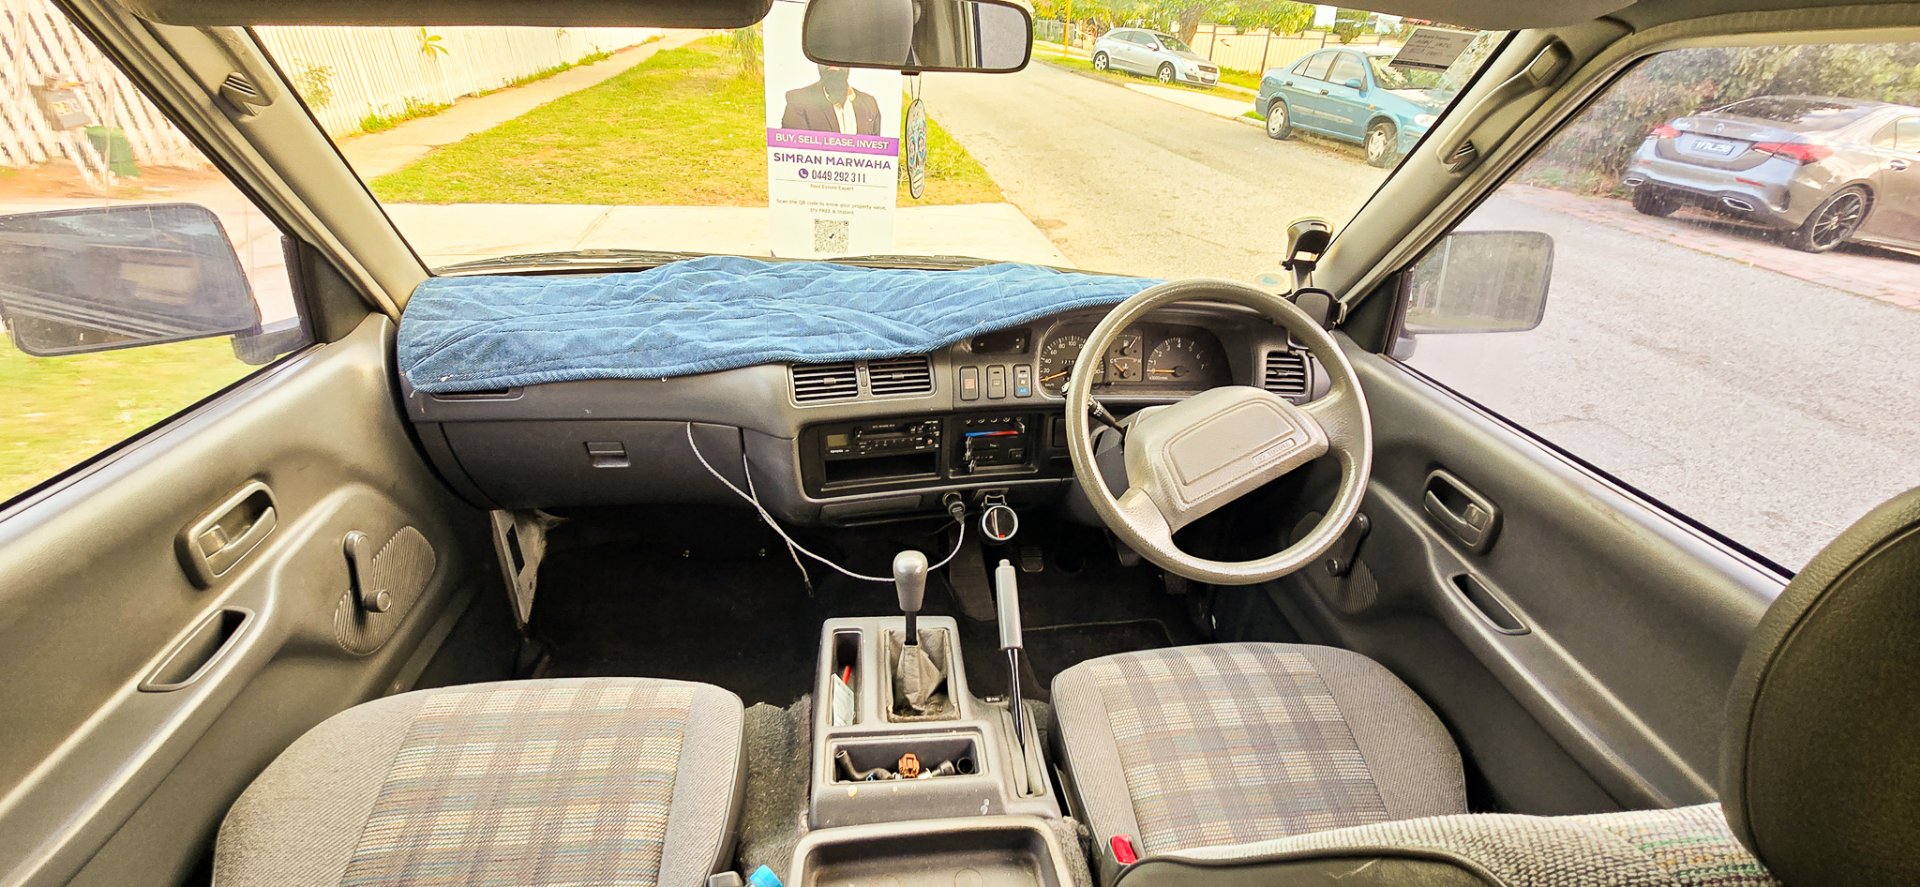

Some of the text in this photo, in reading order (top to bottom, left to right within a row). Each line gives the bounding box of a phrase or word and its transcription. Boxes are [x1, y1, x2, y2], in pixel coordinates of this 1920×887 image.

[856, 139, 889, 150] INVEST
[773, 152, 892, 170] SIMRAN MARWAHA
[811, 169, 866, 183] 0449 292 311
